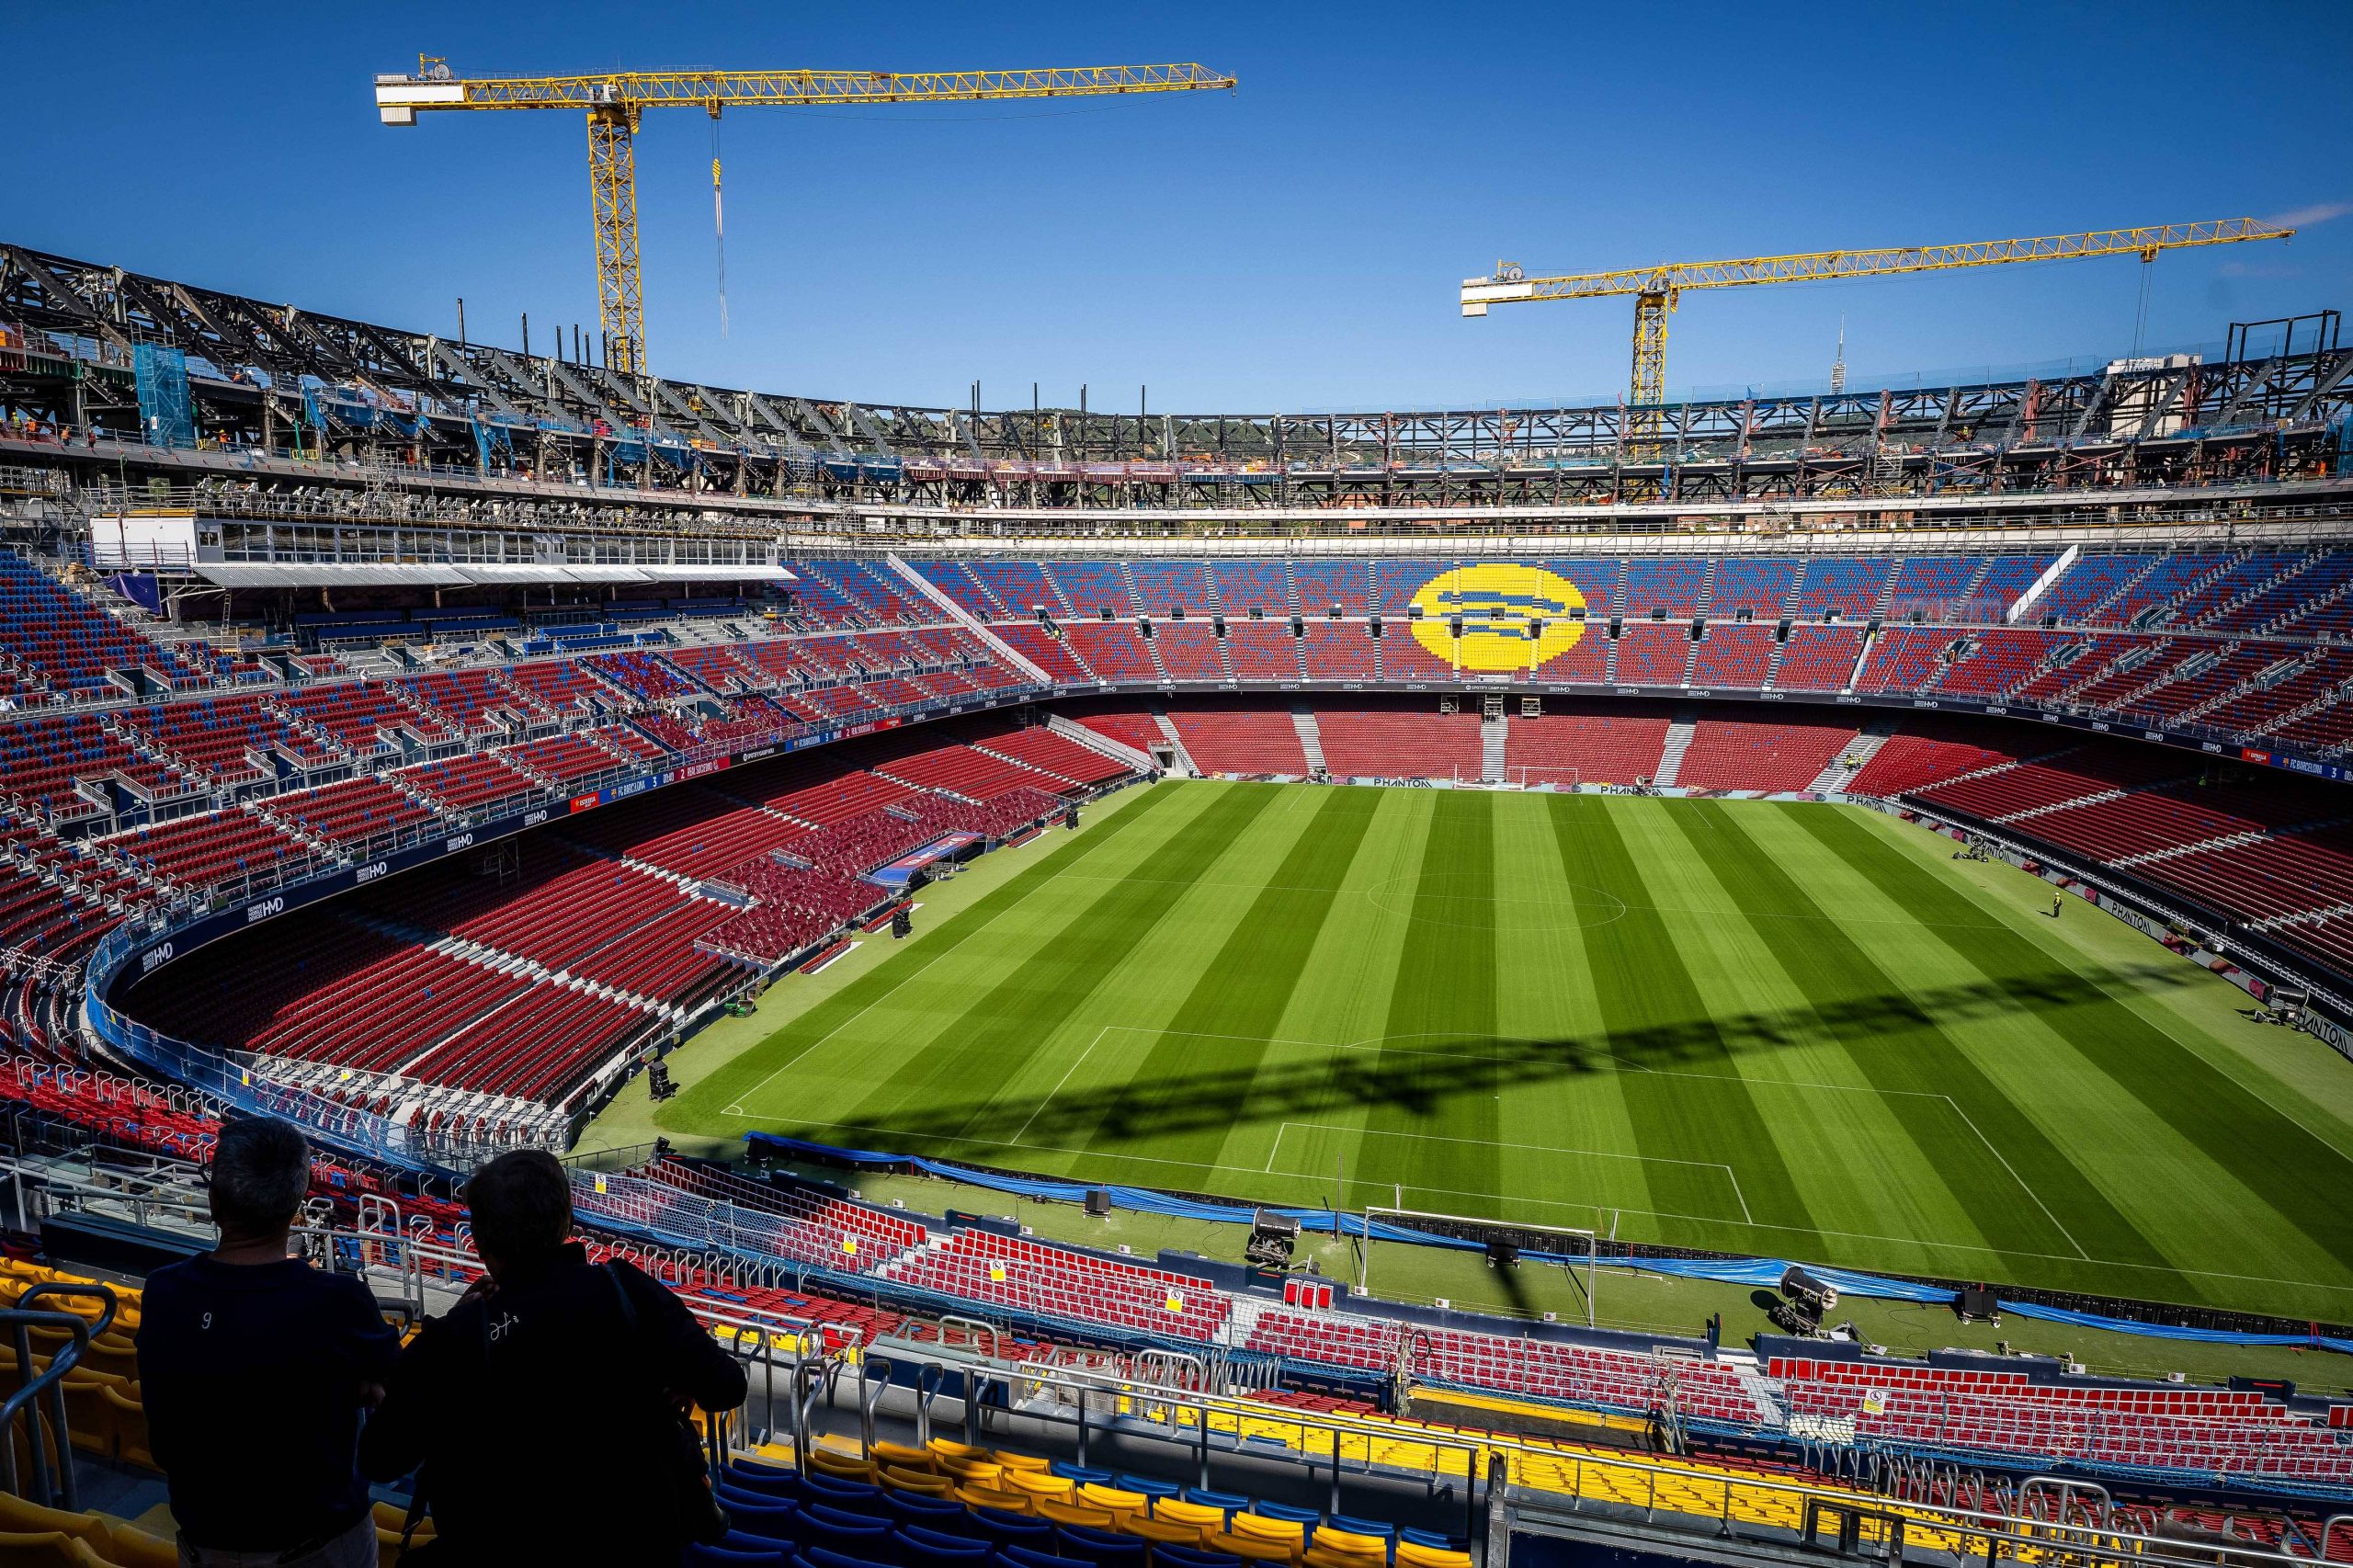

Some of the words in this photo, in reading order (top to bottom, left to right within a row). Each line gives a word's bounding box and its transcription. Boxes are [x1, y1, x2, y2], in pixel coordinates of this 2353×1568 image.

[2297, 760, 2323, 774] BARCELONA
[2332, 767, 2336, 778] 3
[624, 779, 646, 796] BARCELONA
[653, 776, 657, 788] 3
[680, 768, 685, 779] 2
[1374, 778, 1433, 788] PHANTOM
[1847, 795, 1887, 813] PHANTOM
[533, 810, 547, 824] HMD
[458, 833, 473, 848] HMD
[369, 861, 387, 879] HMD
[262, 897, 284, 917] HMD
[2111, 901, 2152, 935] PHANTOM
[153, 942, 174, 966] HMD
[201, 1312, 212, 1330] 9
